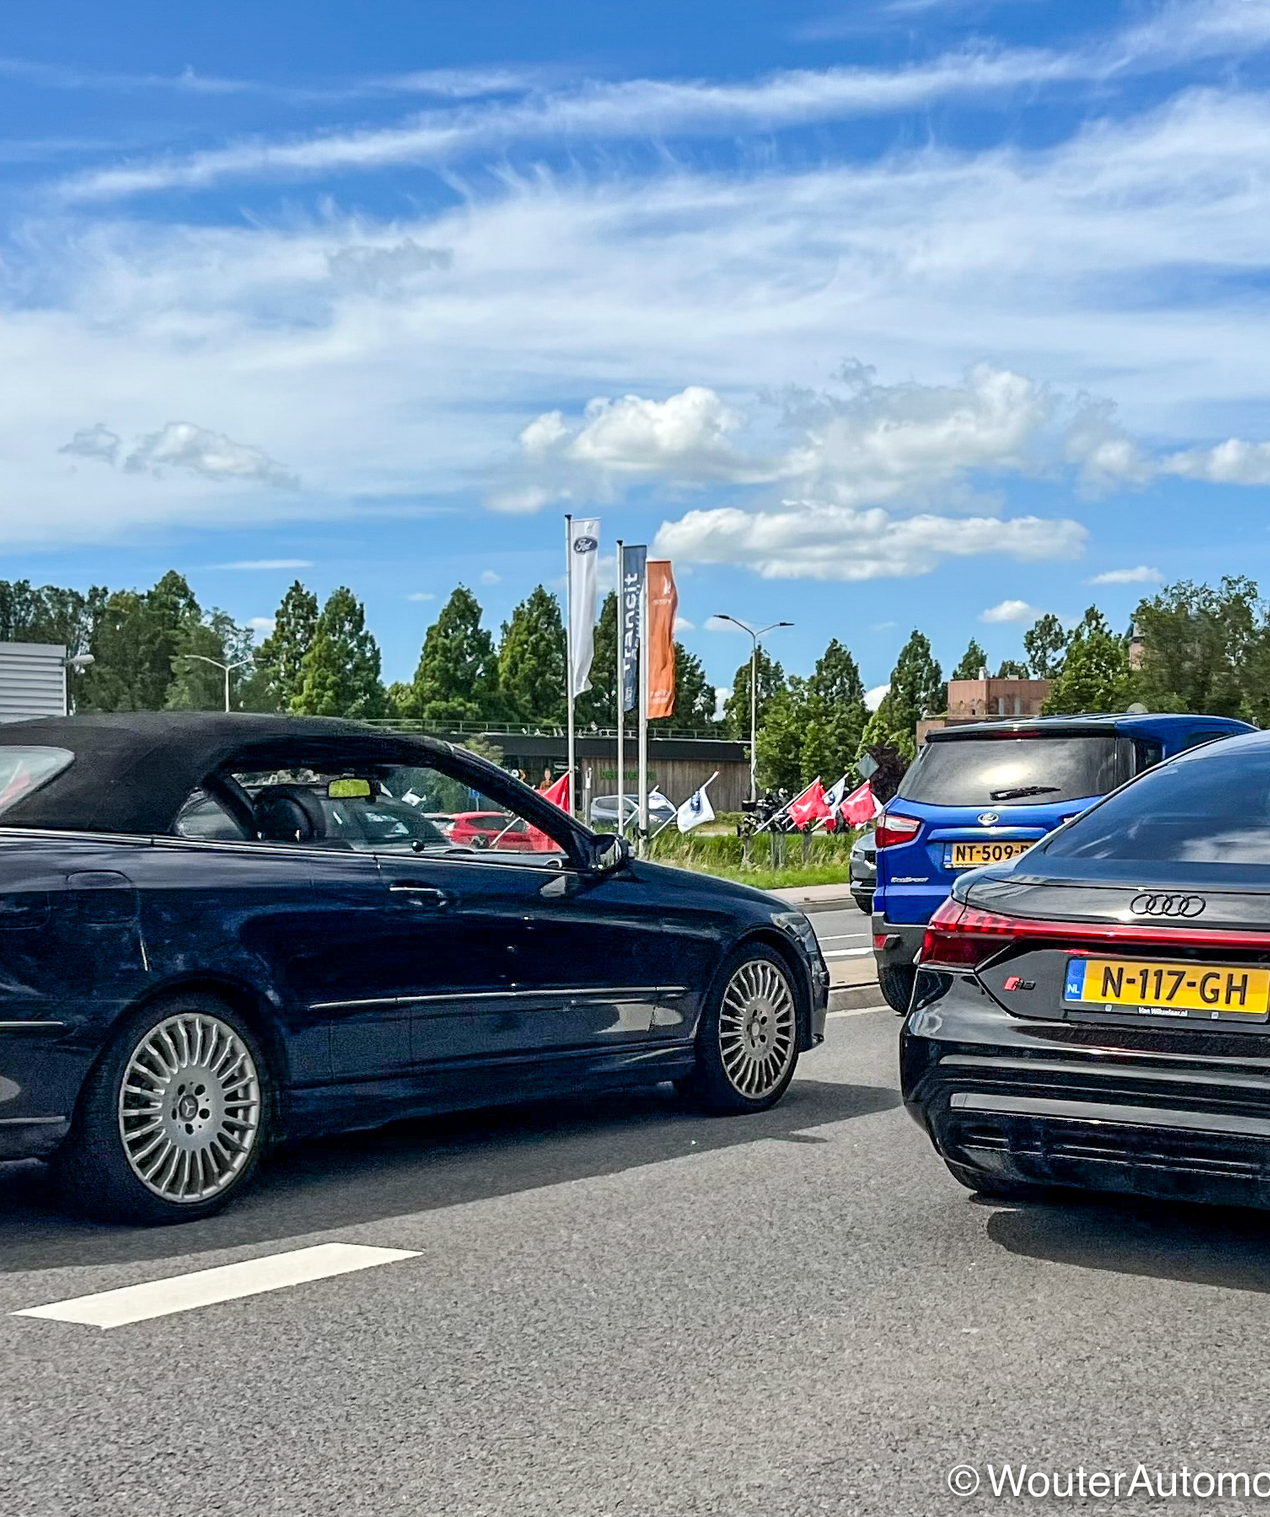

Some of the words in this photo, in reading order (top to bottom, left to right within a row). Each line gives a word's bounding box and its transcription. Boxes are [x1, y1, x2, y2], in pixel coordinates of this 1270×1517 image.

[1067, 983, 1081, 994] NL
[1101, 966, 1248, 1006] N-117-GH
[1138, 1006, 1151, 1014] Van
